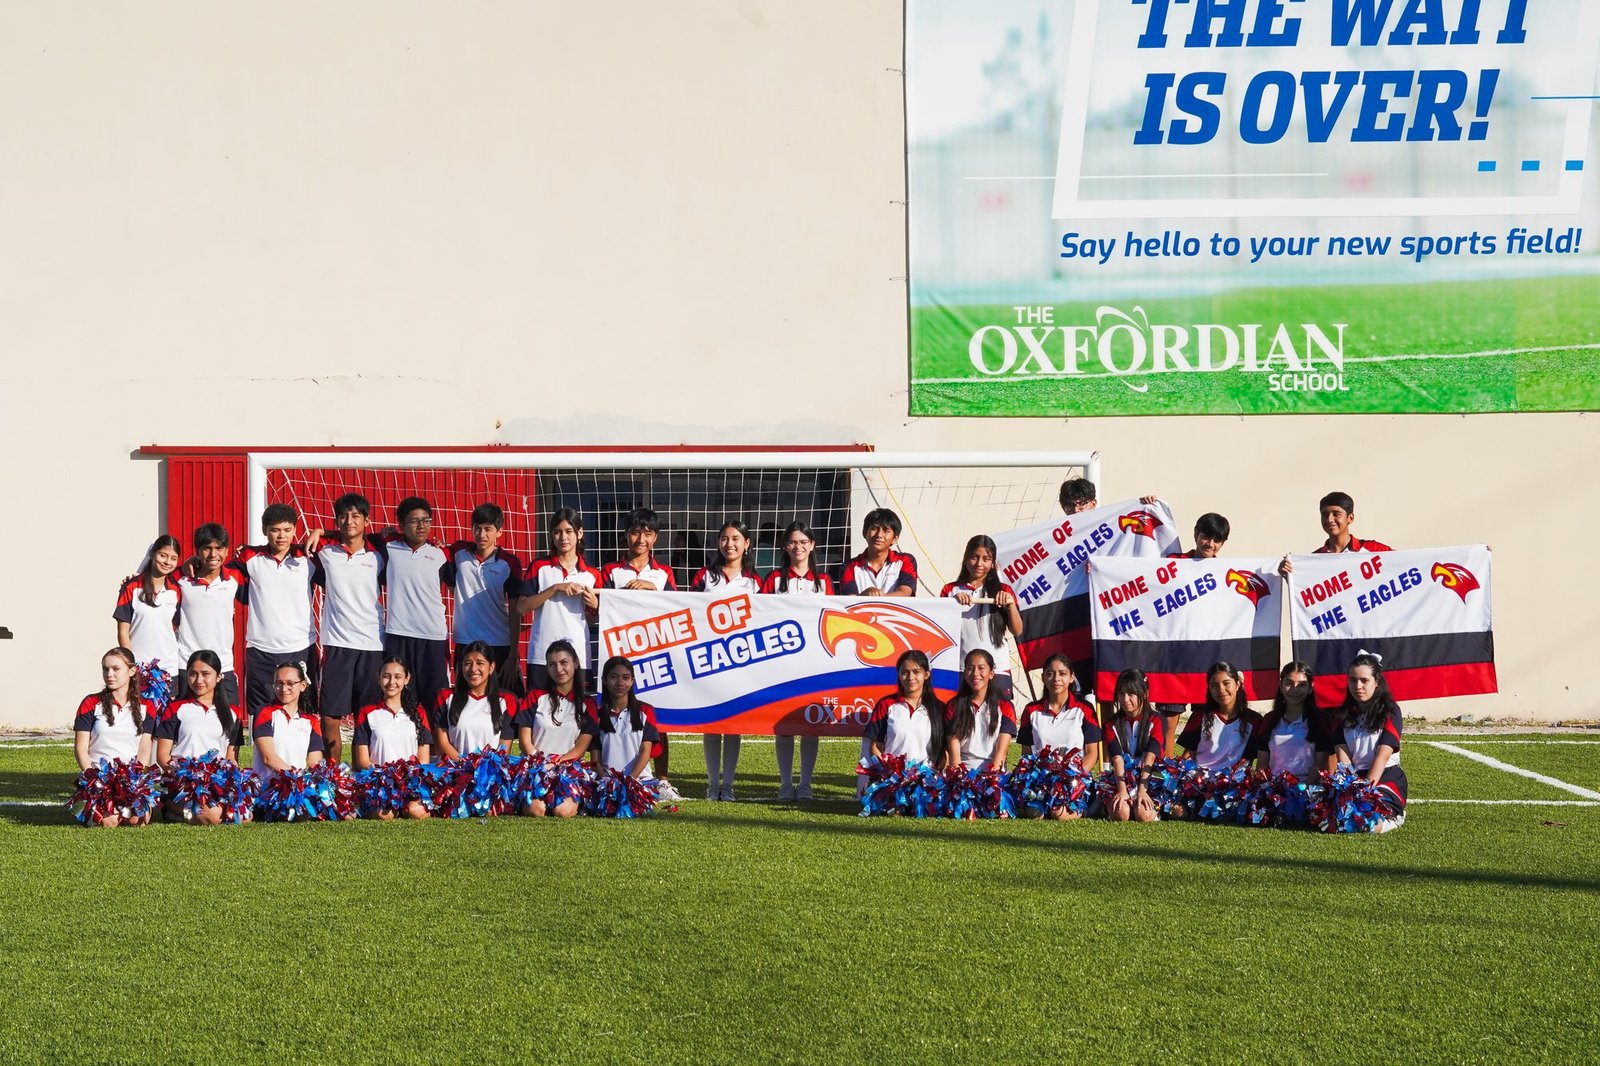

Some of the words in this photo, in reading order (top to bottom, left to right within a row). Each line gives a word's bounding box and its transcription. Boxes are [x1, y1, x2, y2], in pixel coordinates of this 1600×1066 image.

[1132, 0, 1301, 48] THE
[1134, 72, 1226, 145] IS
[1239, 69, 1500, 144] OVER!
[1060, 232, 1116, 264] Say
[1125, 231, 1200, 257] hello
[1211, 233, 1240, 256] to
[1251, 237, 1319, 263] your
[1328, 236, 1391, 256] new
[1399, 233, 1497, 262] sports
[1507, 228, 1582, 254] field!
[1013, 306, 1054, 324] THE
[968, 322, 1350, 376] OXFORDIAN
[1268, 373, 1350, 392] SCHOOL
[1003, 541, 1050, 584] HOME
[1052, 520, 1073, 545] OF
[1018, 574, 1052, 605] THE
[1056, 523, 1114, 576] EAGLES
[1098, 575, 1149, 611] HOME
[1156, 561, 1179, 585] OF
[1108, 608, 1144, 636] THE
[1153, 573, 1217, 618] EAGLES
[1300, 570, 1353, 608] HOME
[1360, 555, 1383, 580] OF
[1311, 604, 1347, 635] THE
[1356, 567, 1423, 615] EAGLES
[605, 610, 695, 658] HOME
[709, 596, 749, 632] OF
[632, 654, 675, 692] HE
[687, 622, 803, 677] EAGLES
[822, 696, 839, 705] THE
